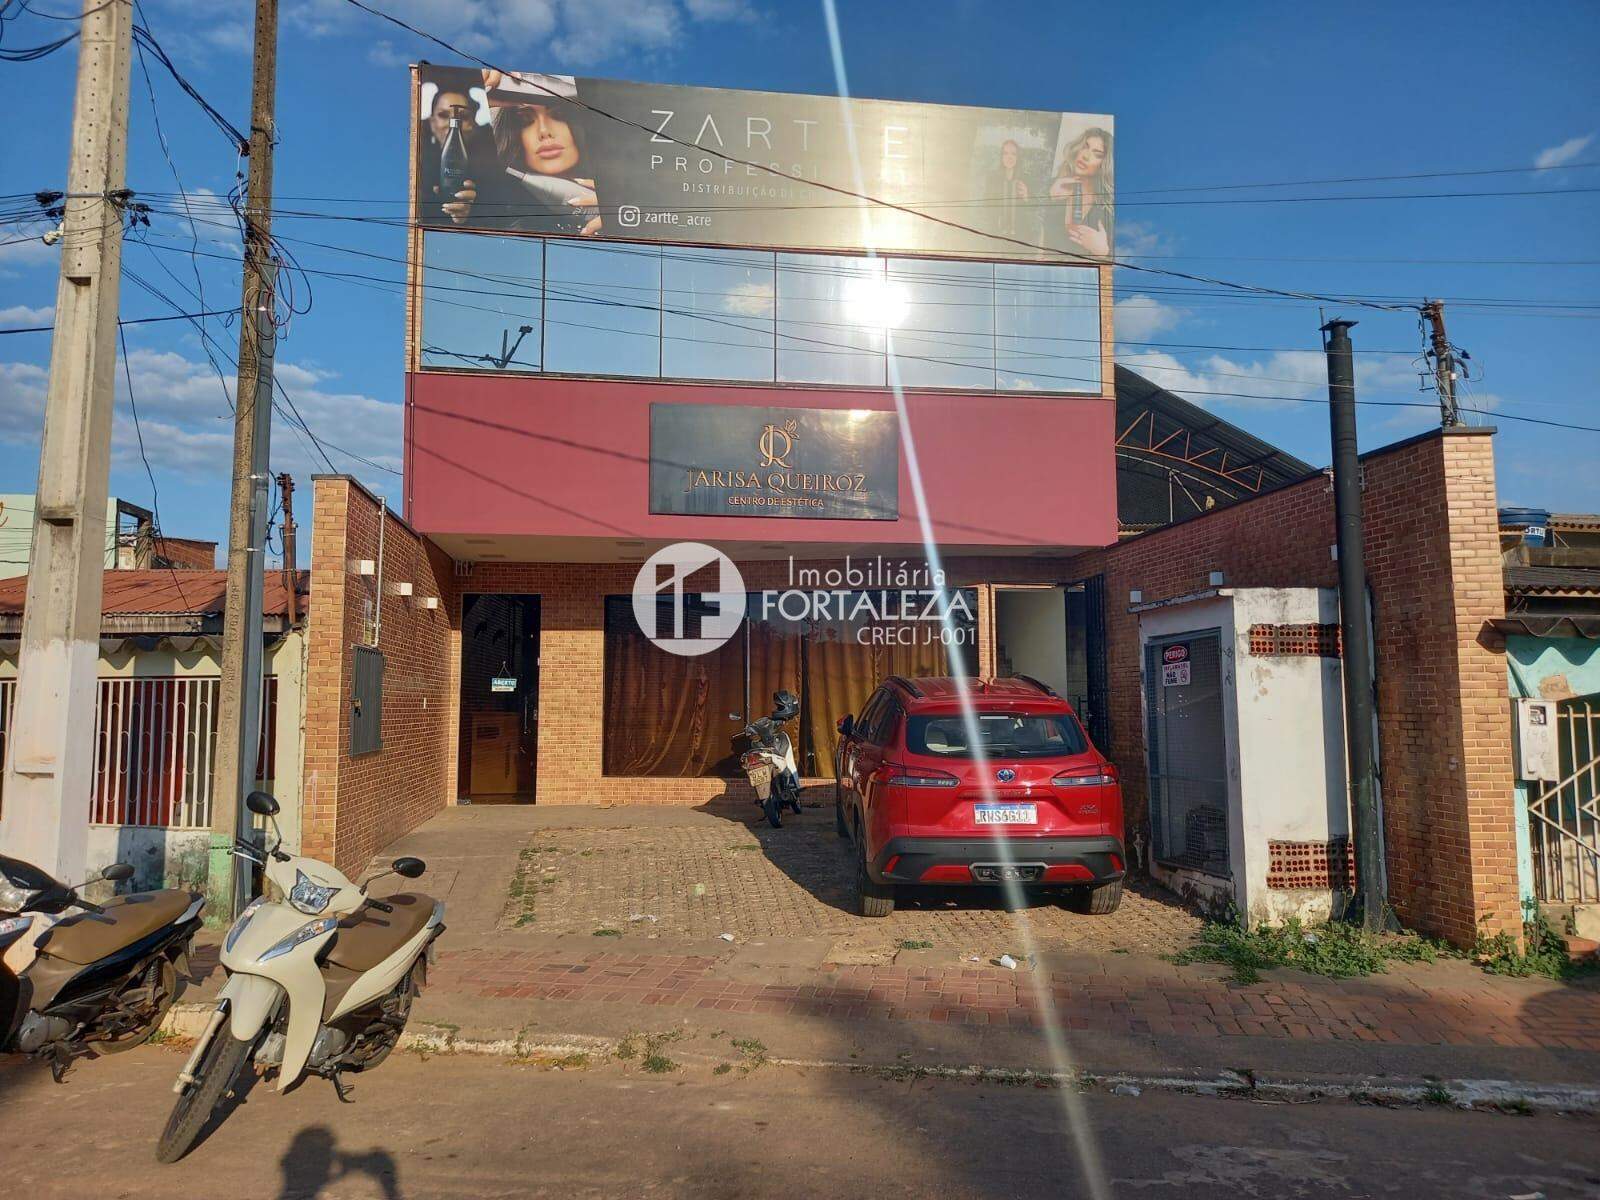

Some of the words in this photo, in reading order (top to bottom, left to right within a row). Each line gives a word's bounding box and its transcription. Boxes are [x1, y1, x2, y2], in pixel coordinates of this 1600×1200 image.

[644, 211, 712, 228] zartte_acre
[683, 469, 762, 493] JARISA
[767, 473, 867, 494] QUEIROZ
[728, 496, 766, 506] CENTRO
[767, 497, 780, 506] DE
